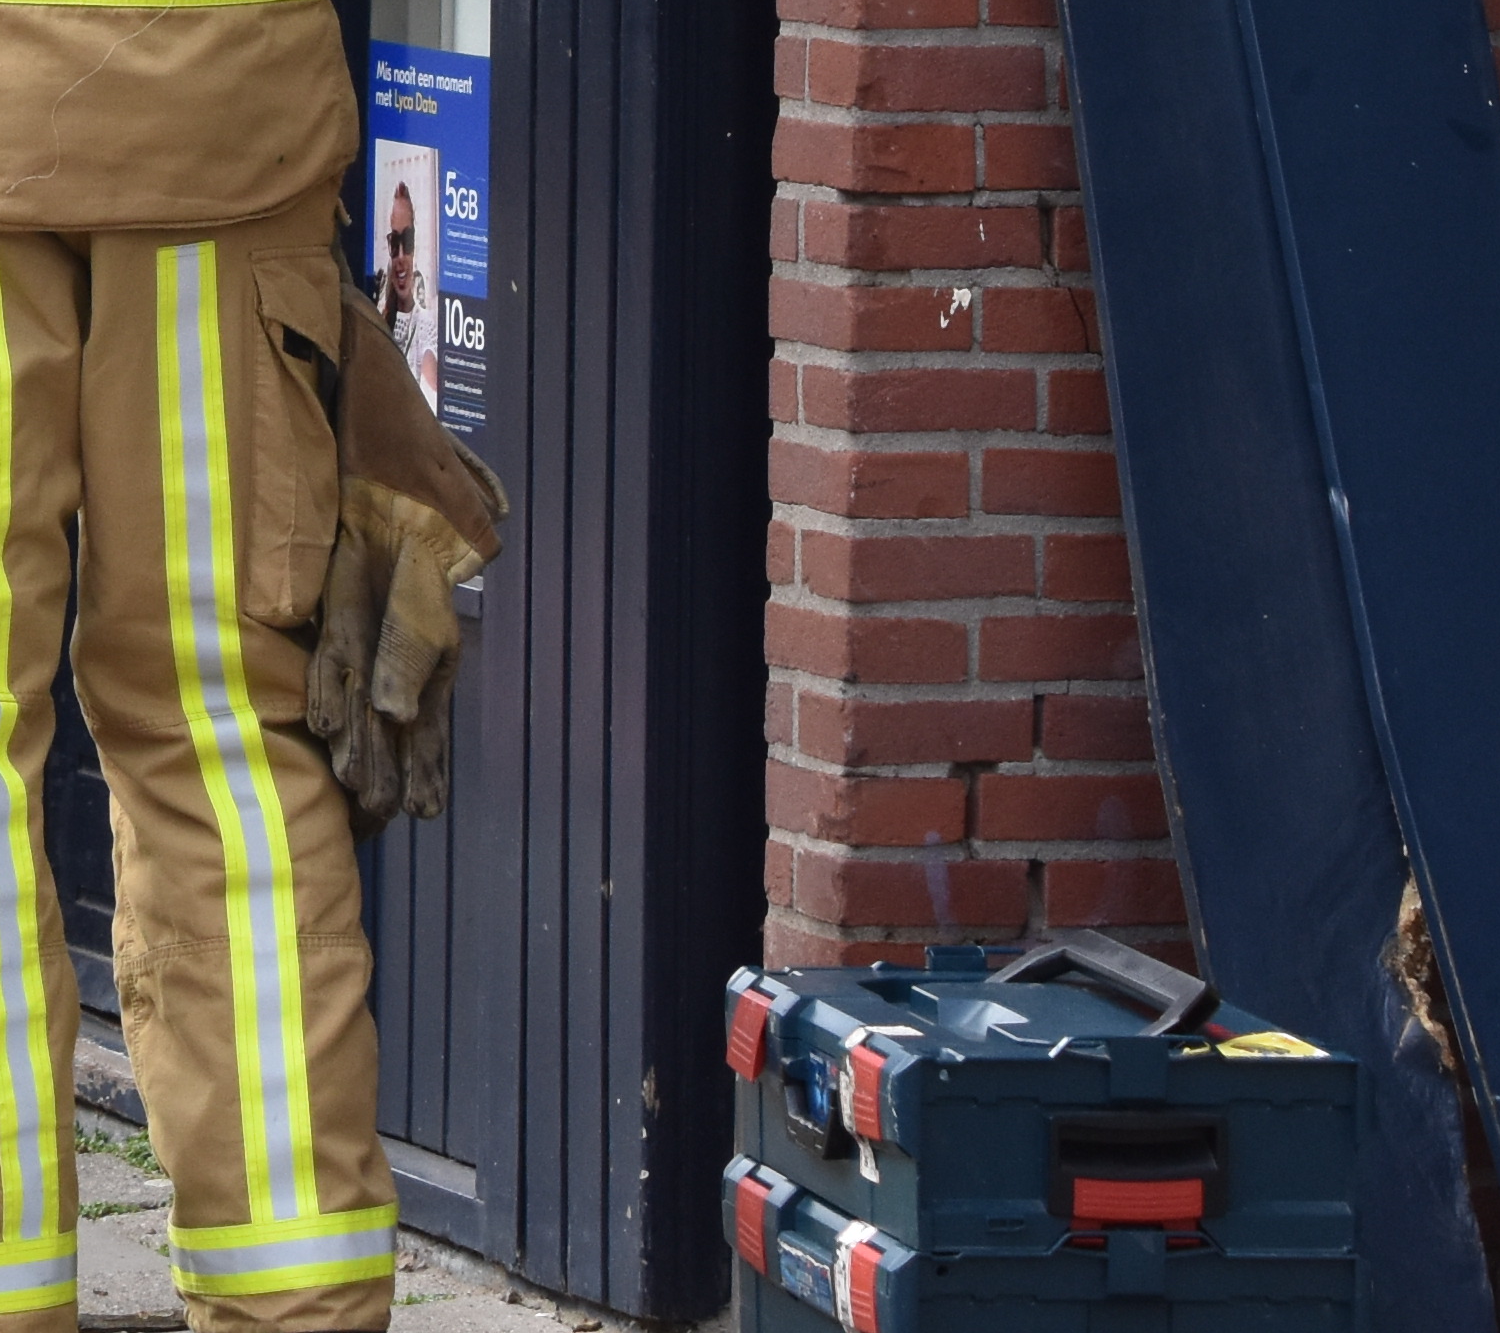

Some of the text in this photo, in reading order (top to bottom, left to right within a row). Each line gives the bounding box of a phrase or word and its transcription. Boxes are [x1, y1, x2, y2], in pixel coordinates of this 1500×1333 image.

[376, 60, 473, 95] Mis nooit een moment
[375, 89, 438, 115] met Lyca Data
[445, 171, 479, 221] 5GB
[445, 297, 486, 351] 10GB
